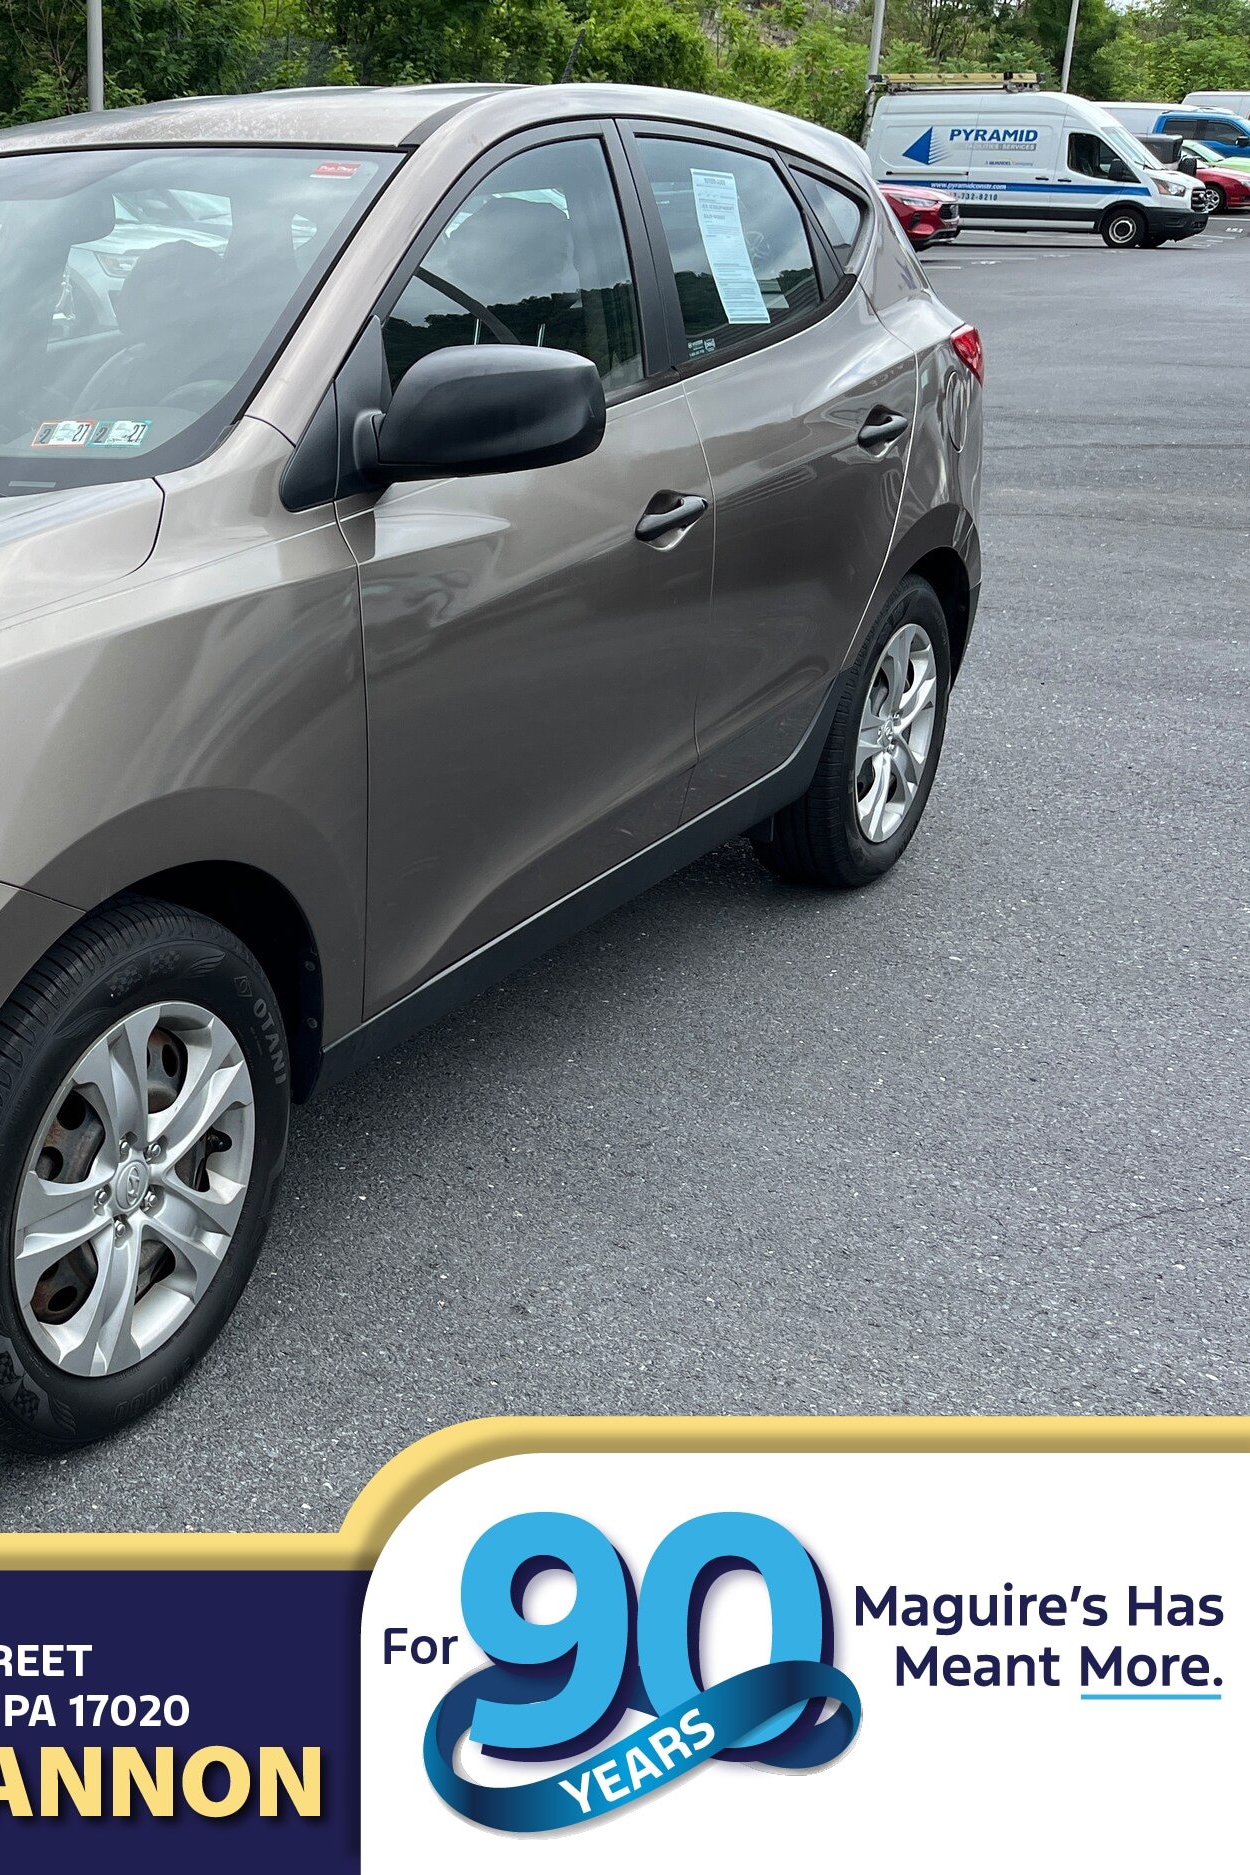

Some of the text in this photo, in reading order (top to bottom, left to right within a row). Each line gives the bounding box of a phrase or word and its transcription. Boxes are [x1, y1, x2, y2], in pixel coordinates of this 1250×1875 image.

[950, 129, 1038, 142] PYRAMID
[1002, 143, 1035, 151] SERVICES
[931, 182, 1007, 190] www.pyramidconstr.com
[72, 424, 90, 442] 27
[128, 425, 146, 442] 27
[254, 999, 287, 1085] OTANI
